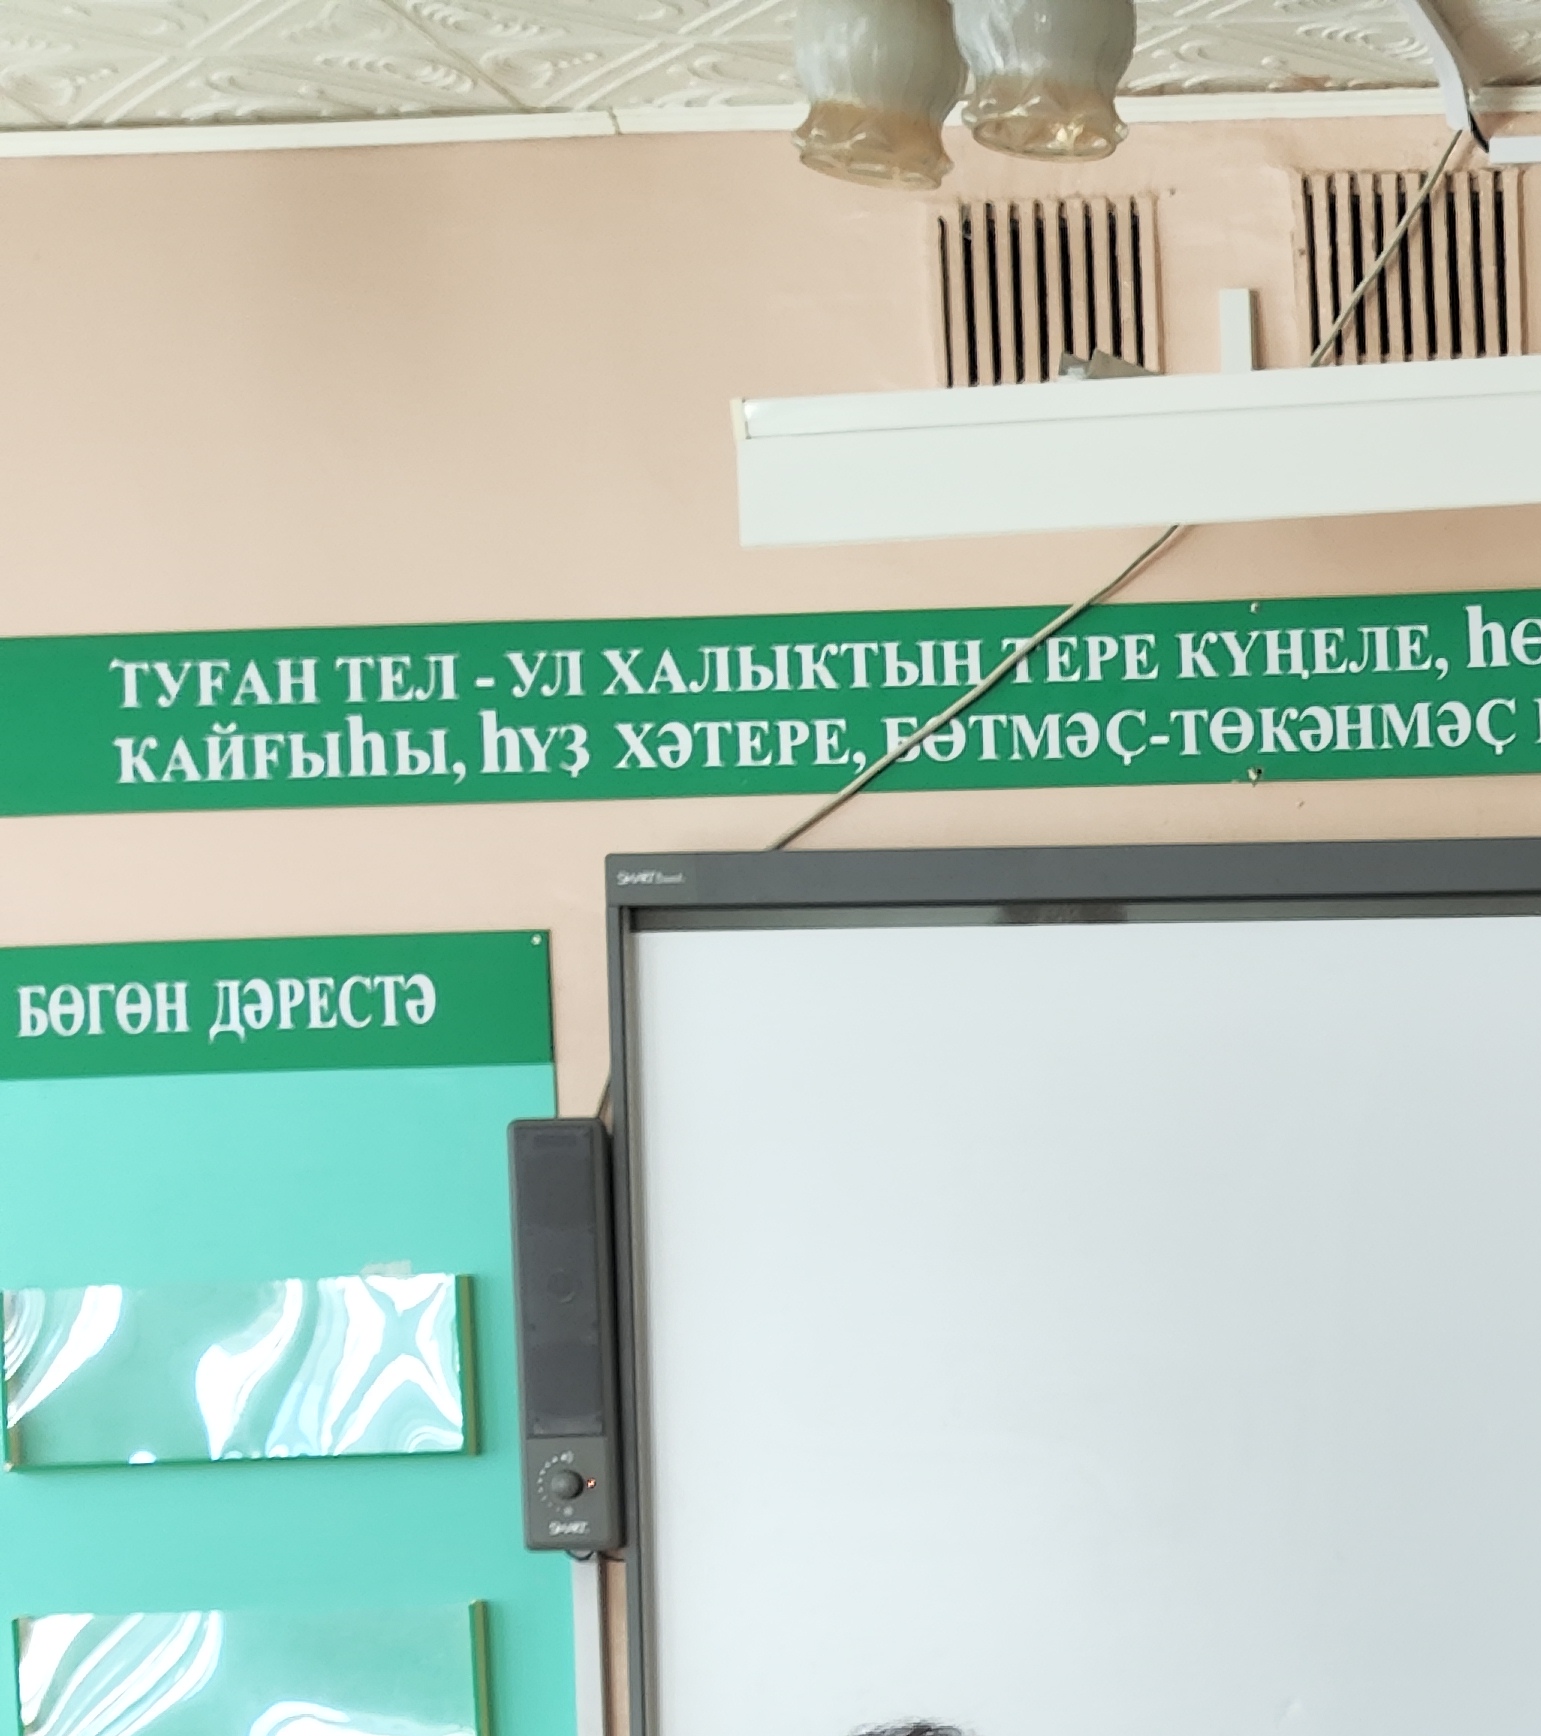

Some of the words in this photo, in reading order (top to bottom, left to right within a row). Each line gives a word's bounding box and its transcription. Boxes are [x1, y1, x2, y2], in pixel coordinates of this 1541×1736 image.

[110, 656, 320, 708] ТУҒАН
[335, 652, 459, 702] ТЕЛ
[504, 649, 585, 698] УЛ
[1001, 632, 1161, 685] ТЕРЕ
[1176, 624, 1450, 682] КҮҢЕЛЕ,
[613, 717, 868, 774] ХӘТЕРЕ,
[17, 980, 192, 1039] БӨГӨН
[209, 973, 437, 1044] ДӘРЕСТӘ
